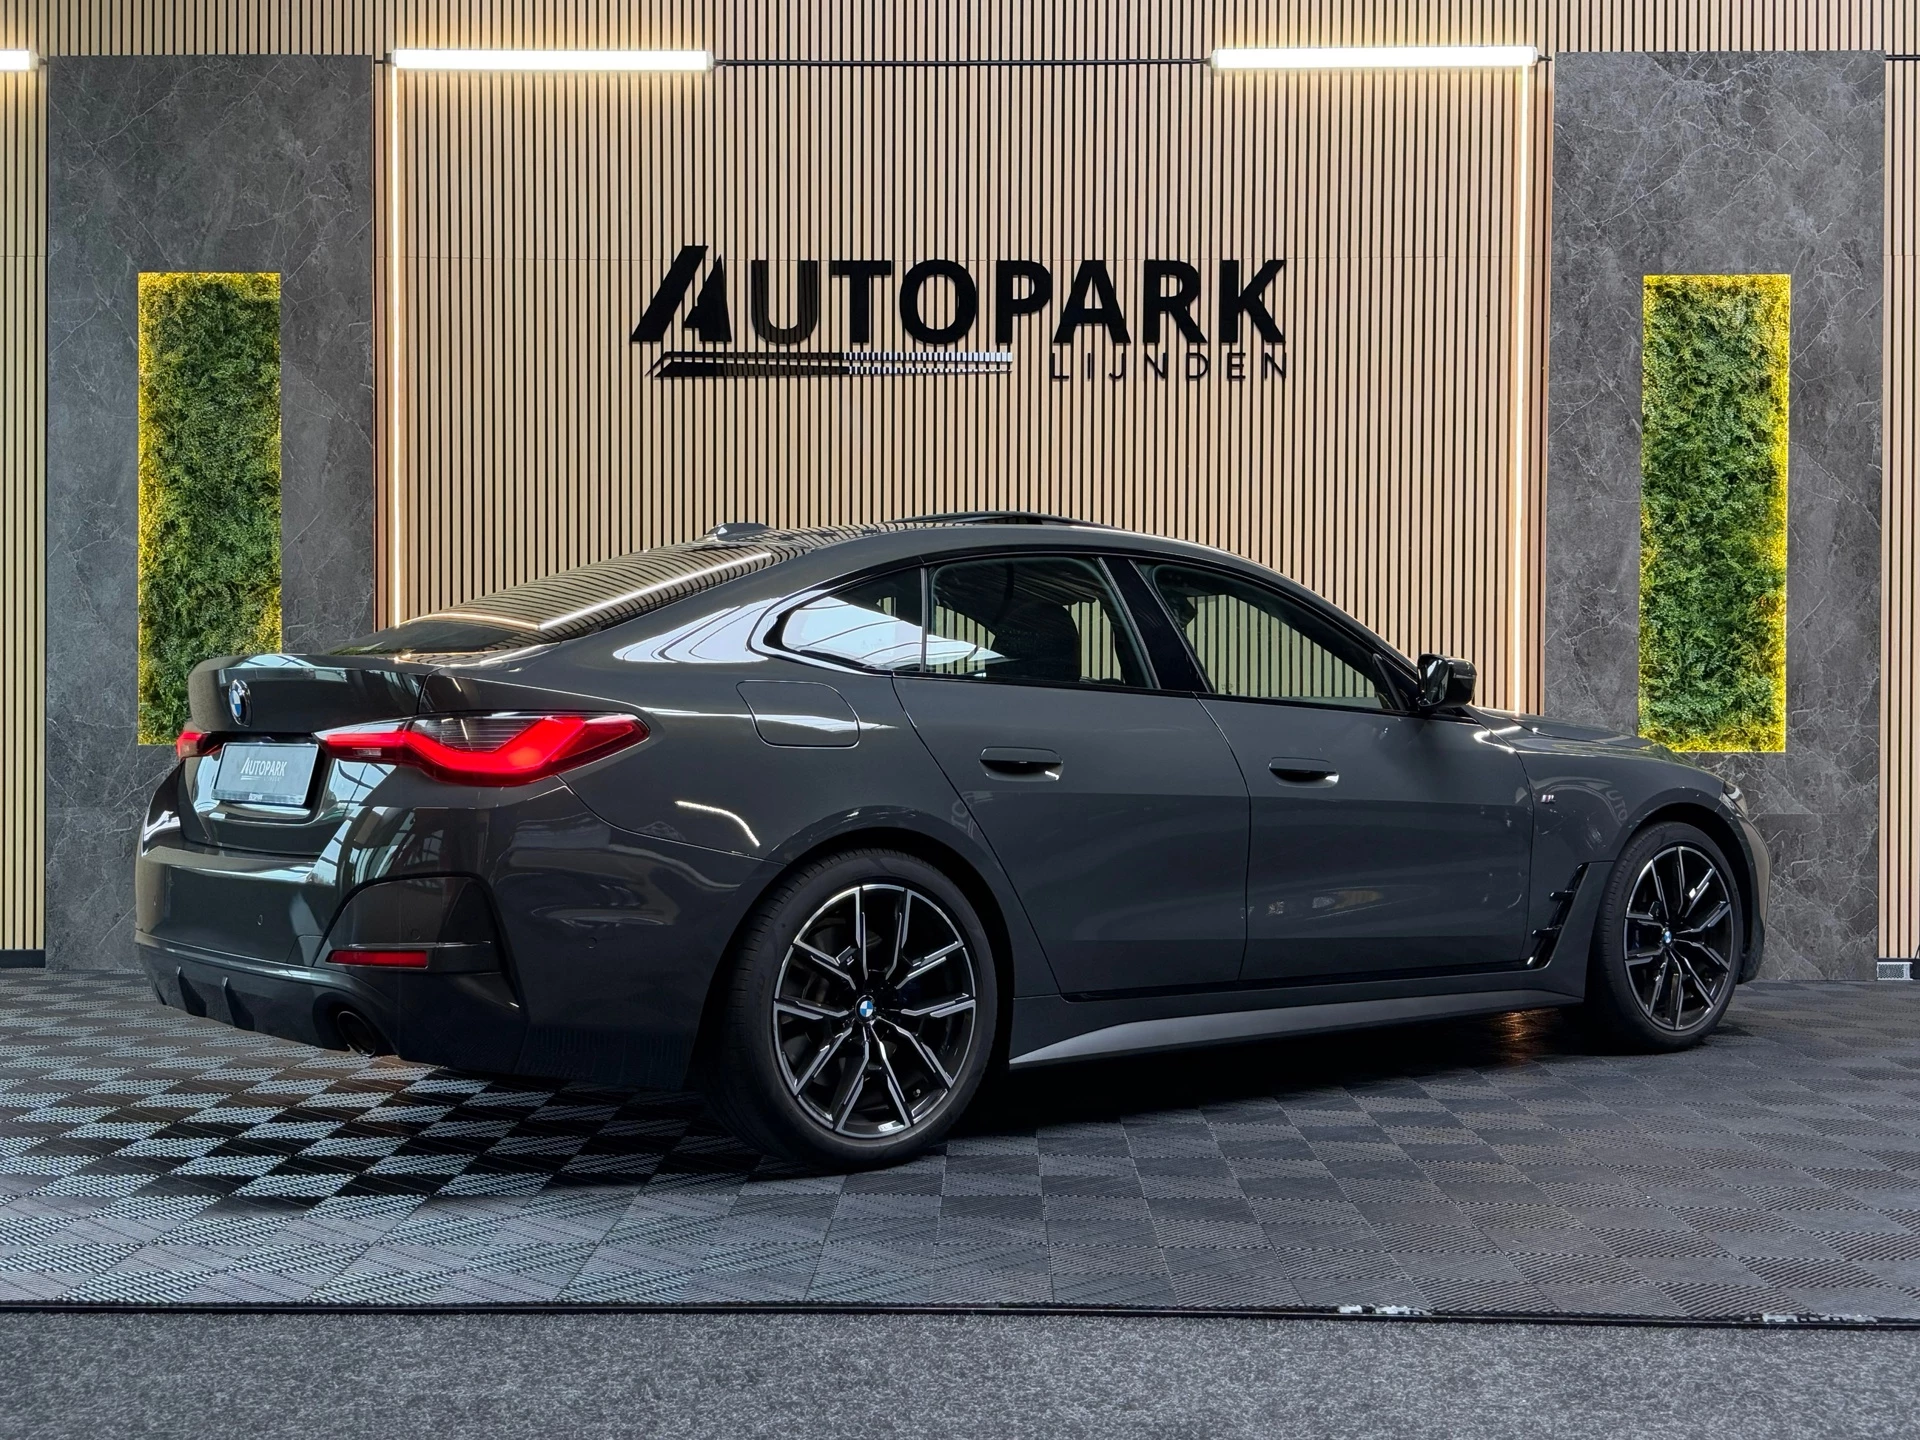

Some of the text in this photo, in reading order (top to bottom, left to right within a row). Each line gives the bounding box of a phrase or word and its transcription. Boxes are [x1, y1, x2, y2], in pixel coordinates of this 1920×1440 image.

[630, 245, 1287, 344] AUTOPARK
[1051, 352, 1287, 380] LIJNDEN
[241, 758, 287, 776] AUTOPARK
